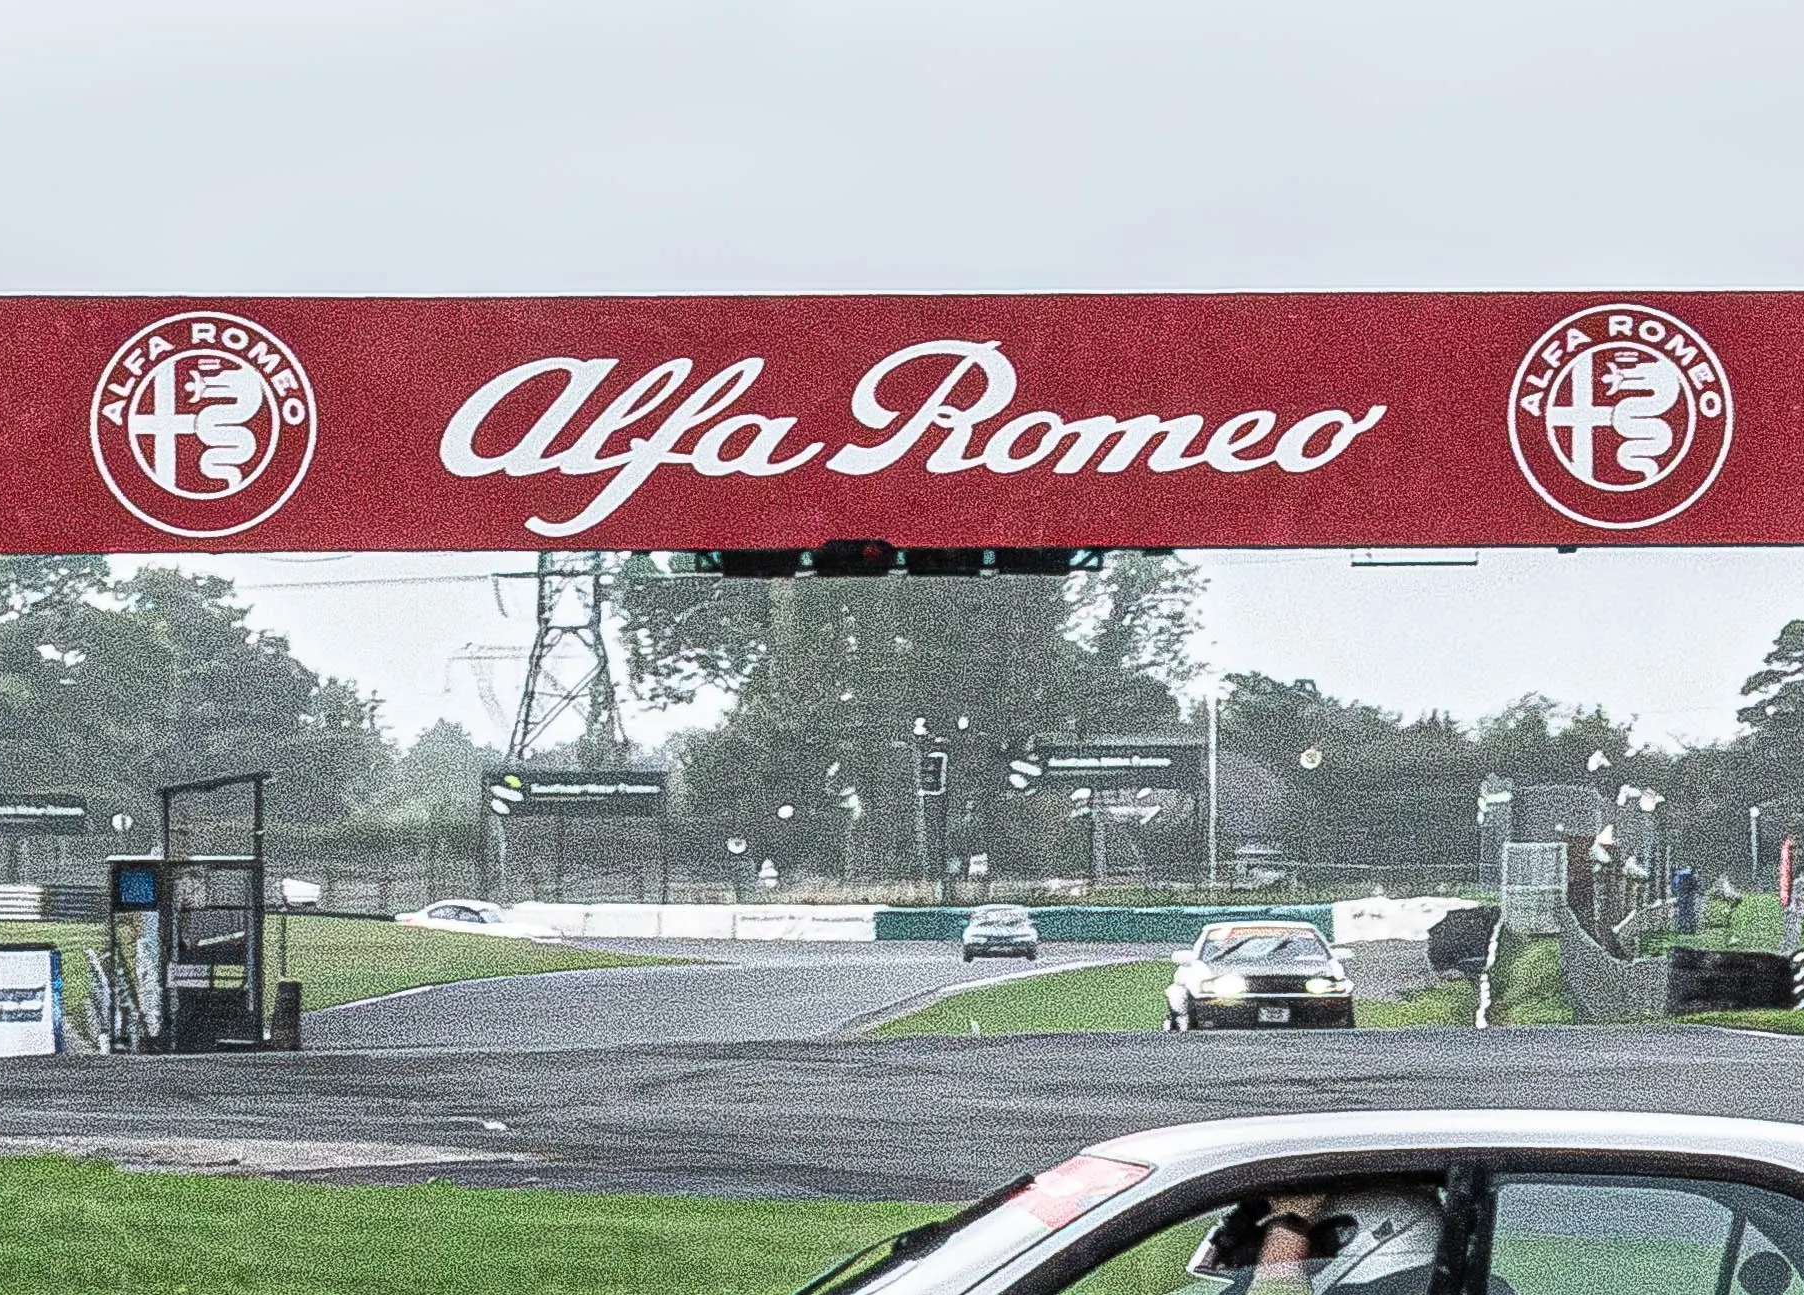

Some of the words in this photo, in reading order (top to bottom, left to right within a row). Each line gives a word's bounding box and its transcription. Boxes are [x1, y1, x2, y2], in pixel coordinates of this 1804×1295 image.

[100, 333, 175, 428] ALFA
[190, 320, 307, 429] ROMEO
[1517, 326, 1592, 417] ALFA
[1607, 313, 1724, 419] ROMEO
[438, 355, 825, 539] Alfa
[824, 338, 1388, 477] Romeo
